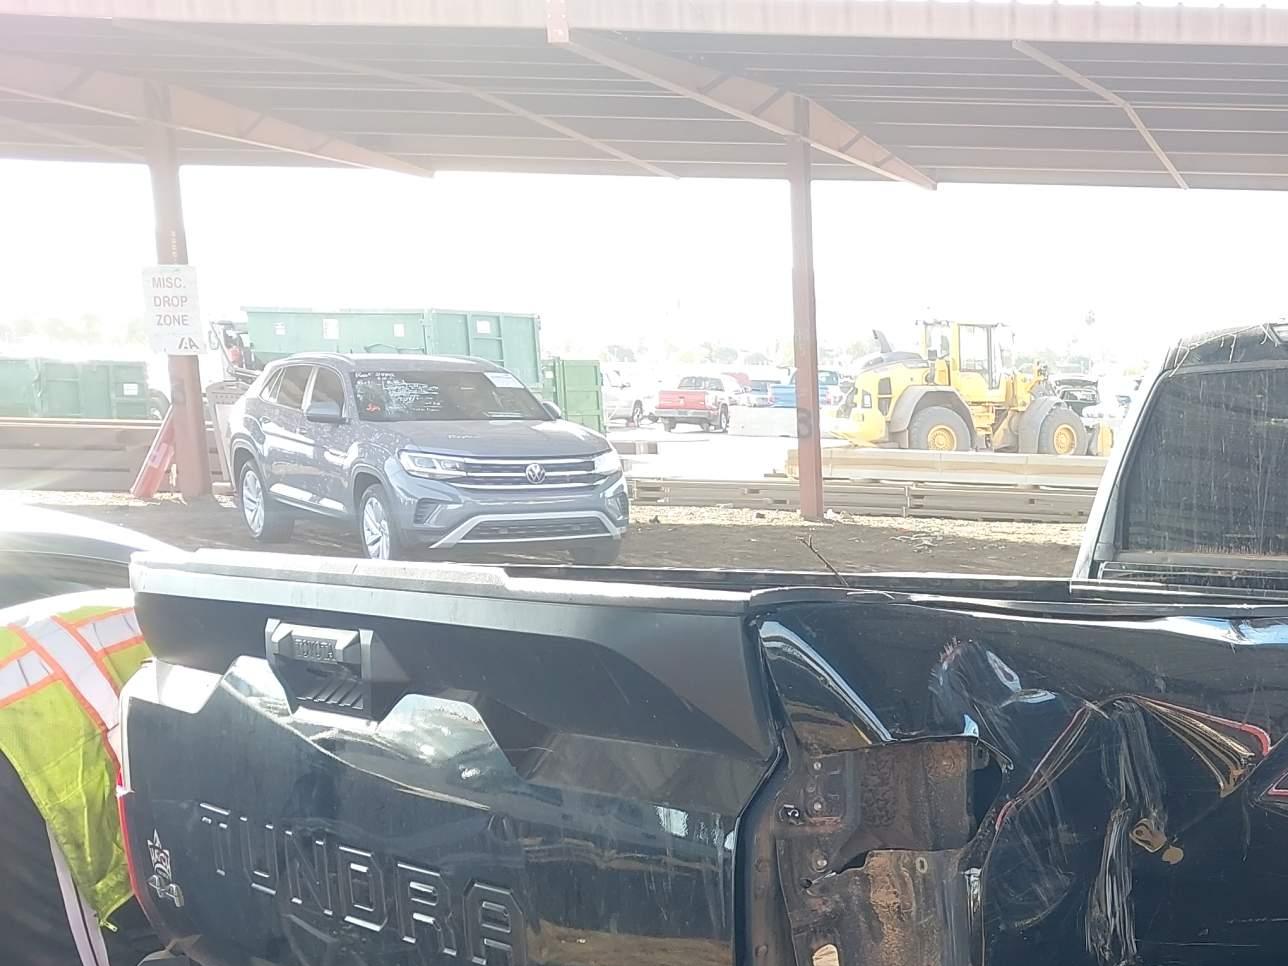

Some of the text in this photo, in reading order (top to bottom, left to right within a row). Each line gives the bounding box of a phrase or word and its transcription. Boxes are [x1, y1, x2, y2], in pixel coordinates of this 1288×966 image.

[152, 277, 186, 288] MISC.
[153, 295, 188, 308] DROP
[156, 314, 190, 326] ZONE
[295, 638, 337, 661] TOYOTA
